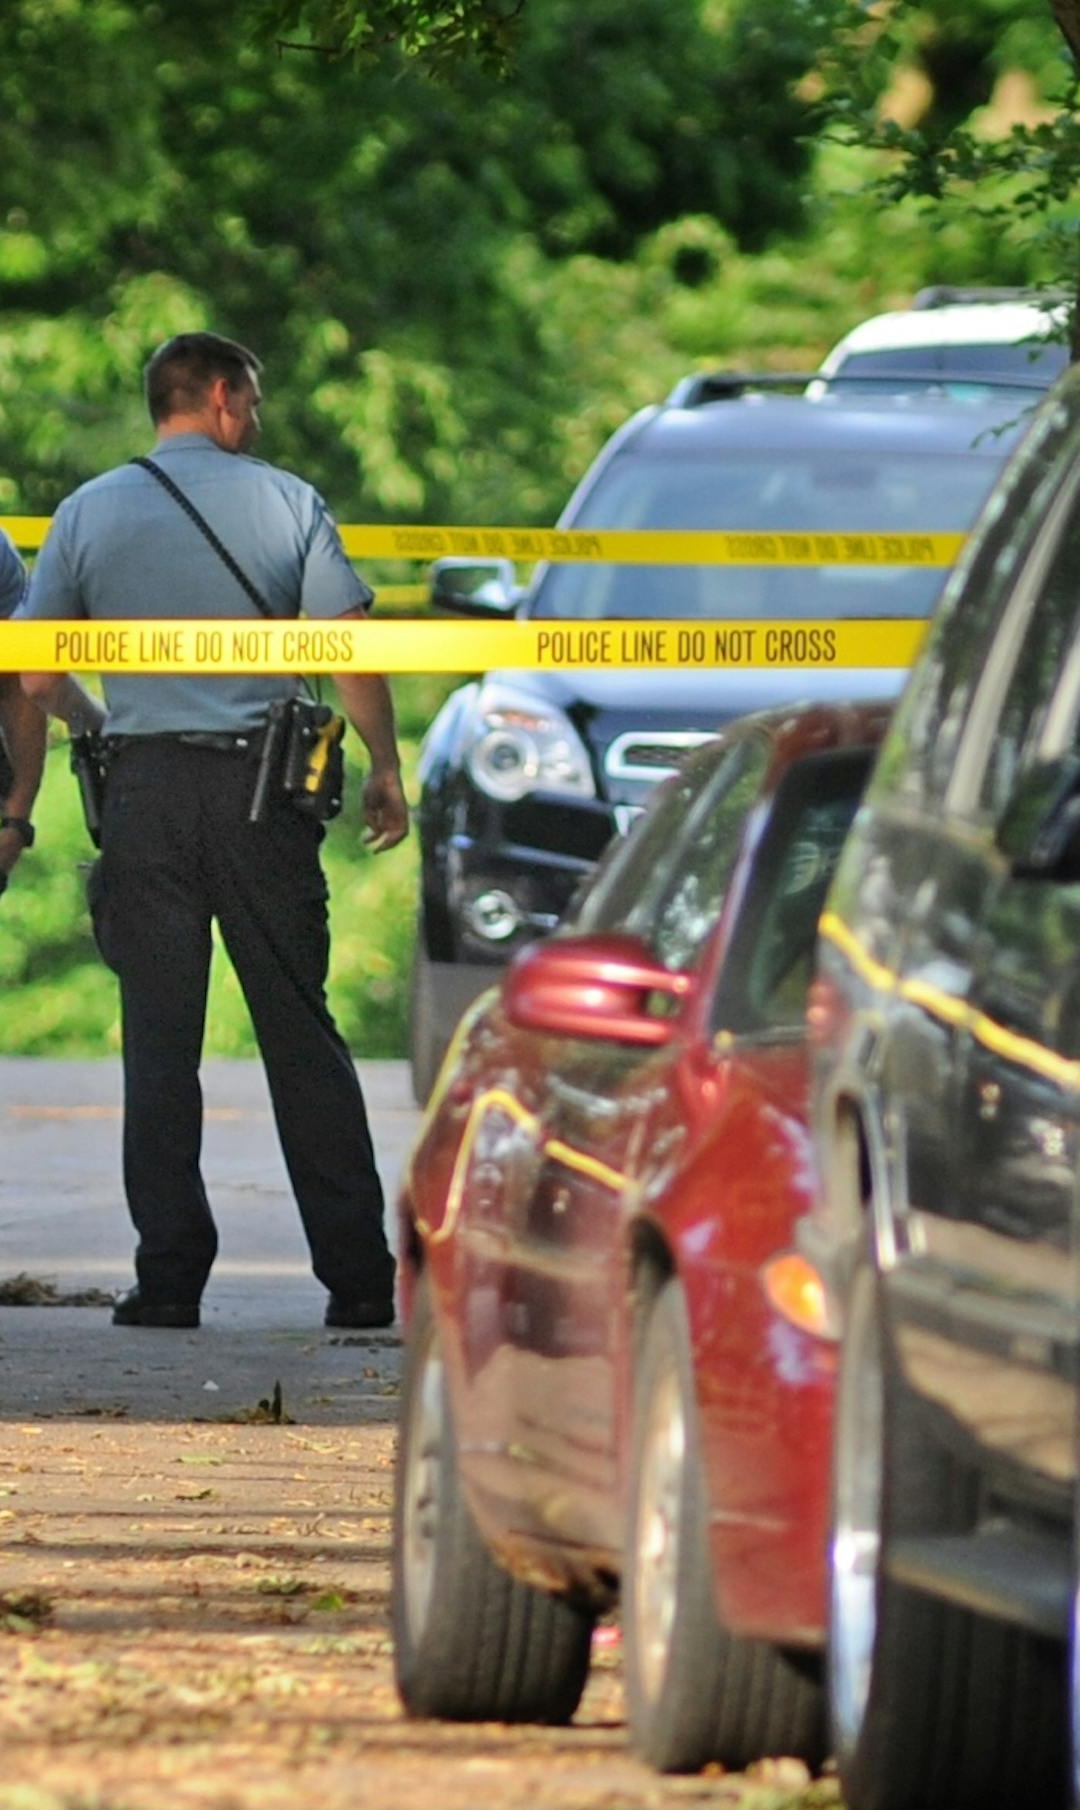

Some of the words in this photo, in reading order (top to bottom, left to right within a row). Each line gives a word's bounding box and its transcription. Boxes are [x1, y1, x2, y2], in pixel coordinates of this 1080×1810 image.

[55, 631, 129, 663] POLICE
[139, 631, 183, 663] LINE
[195, 631, 222, 663] DO
[232, 631, 272, 662] NOT
[282, 630, 353, 663] CROSS
[537, 631, 612, 664] POLICE
[622, 631, 667, 663] LINE
[678, 631, 706, 663] DO
[715, 631, 755, 662] NOT
[765, 629, 837, 662] CROSS
